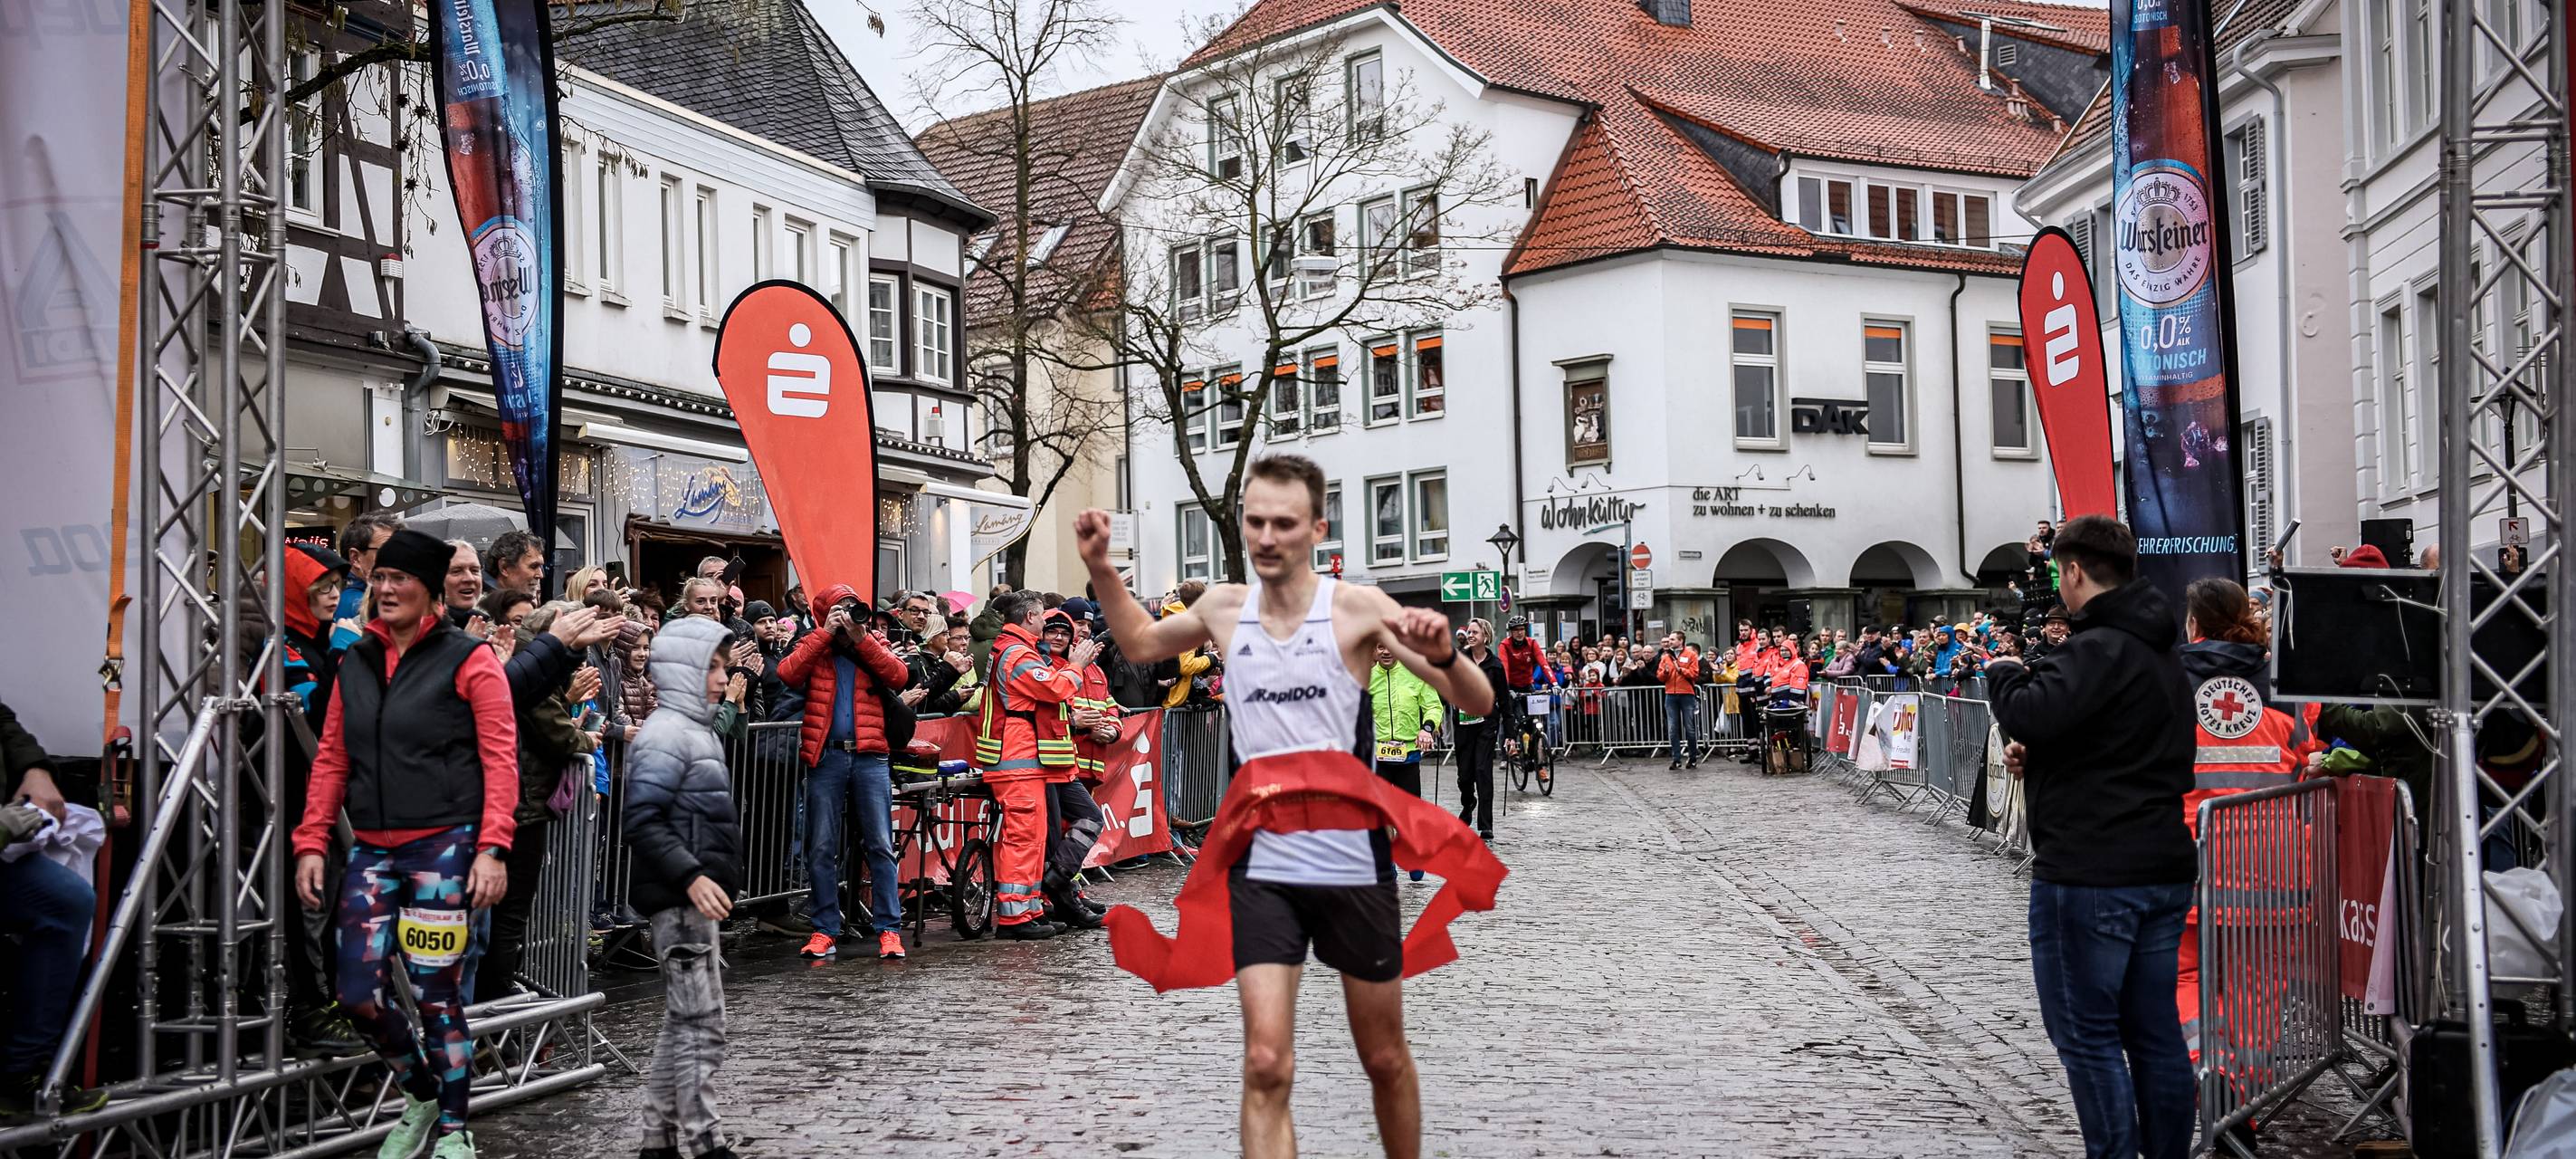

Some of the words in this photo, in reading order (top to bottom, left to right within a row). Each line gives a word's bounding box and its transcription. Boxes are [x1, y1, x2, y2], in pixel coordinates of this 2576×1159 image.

[2119, 218, 2208, 256] Warsteiner
[2125, 263, 2140, 281] DAS
[2174, 256, 2201, 286] WAHRE
[1791, 398, 1870, 435] DAK
[1693, 487, 1711, 501] die
[1713, 487, 1740, 501] ART
[1693, 505, 1706, 516] zu
[1710, 502, 1755, 516] wohnen
[1769, 506, 1782, 517] zu
[1785, 503, 1837, 518] schenken
[2203, 680, 2256, 704] DEUTSCHES
[2199, 703, 2222, 731] ROTES
[2226, 710, 2256, 733] KREUZ
[405, 926, 455, 952] 6050
